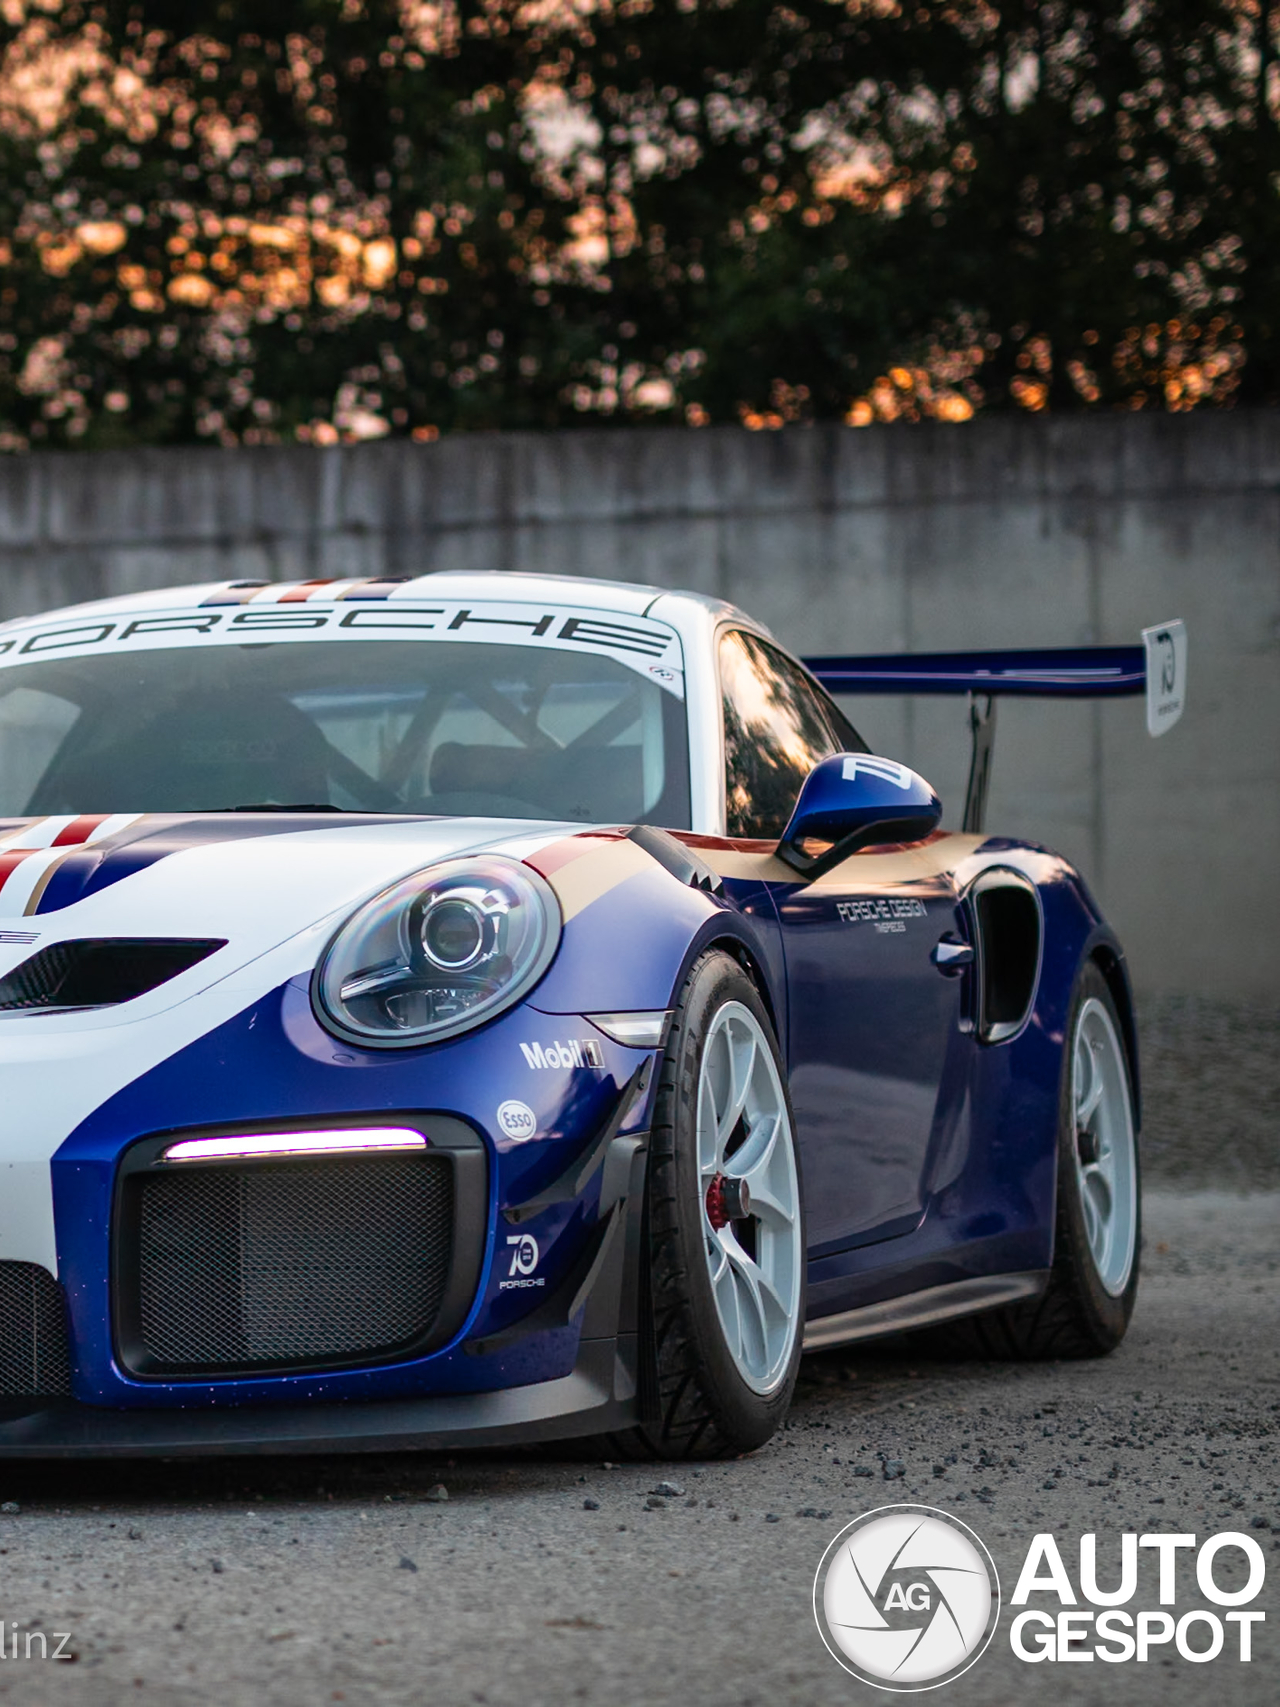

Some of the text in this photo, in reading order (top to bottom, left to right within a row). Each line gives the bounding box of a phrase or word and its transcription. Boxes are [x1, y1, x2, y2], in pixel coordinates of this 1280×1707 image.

[836, 900, 892, 922] PORSCHE
[518, 1040, 585, 1069] Mobil
[503, 1111, 531, 1128] Esso
[506, 1234, 539, 1276] 70
[499, 1278, 545, 1289] PORSCHE
